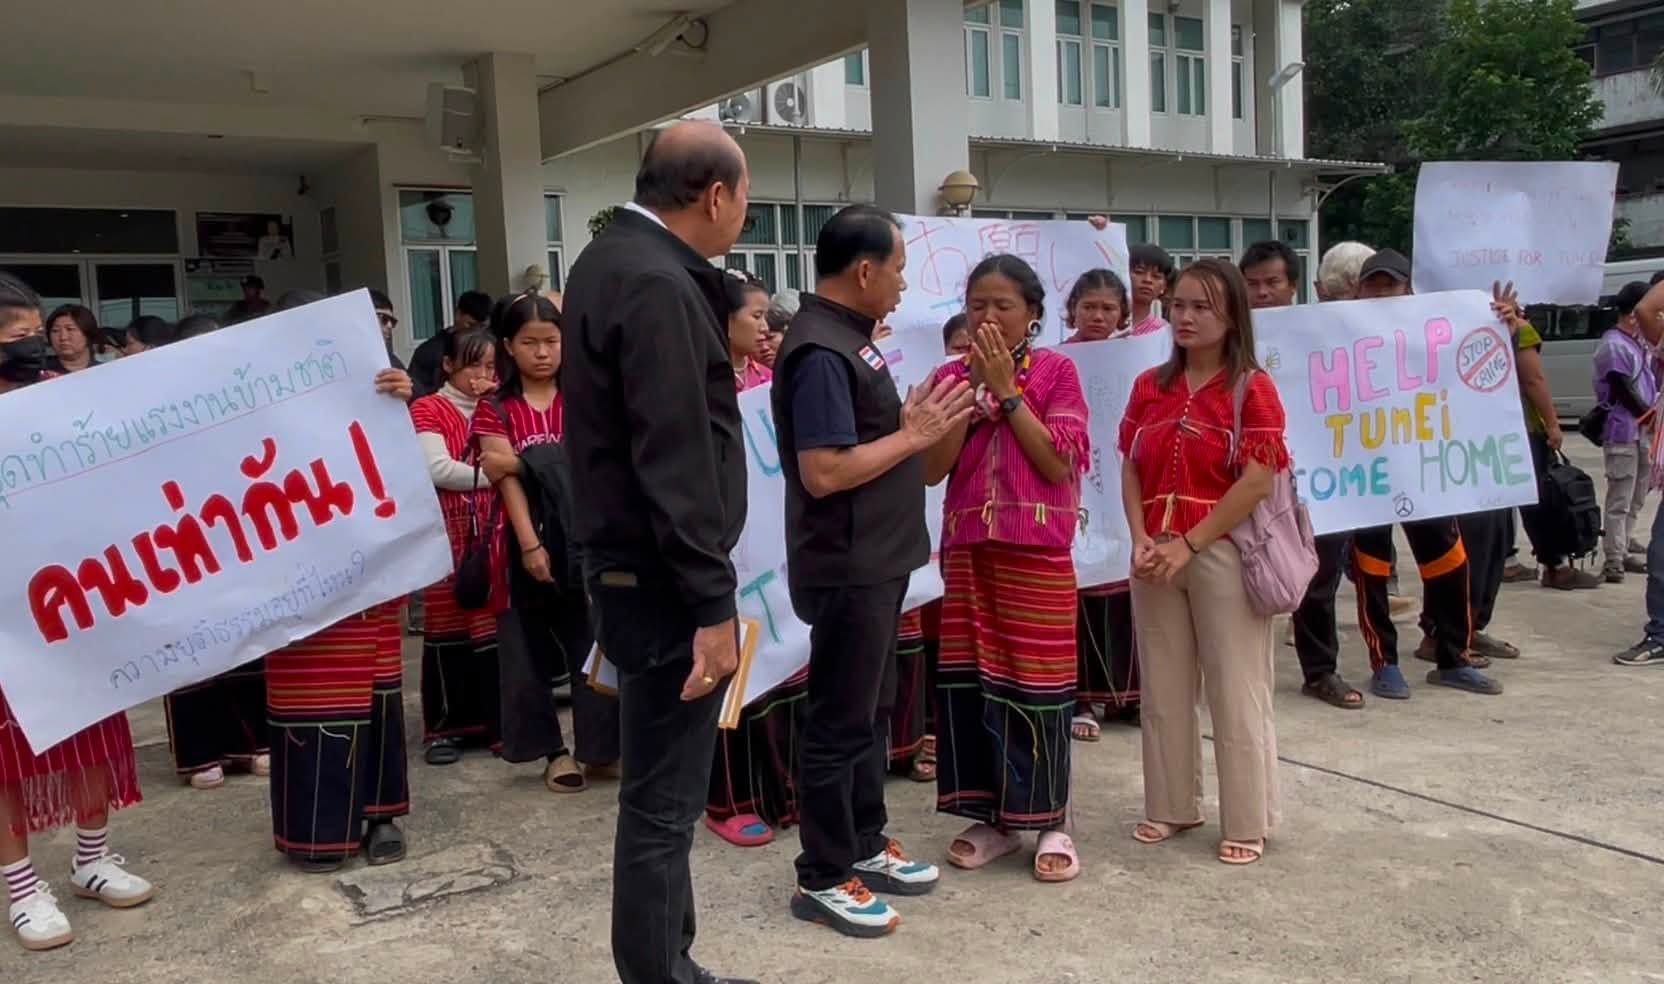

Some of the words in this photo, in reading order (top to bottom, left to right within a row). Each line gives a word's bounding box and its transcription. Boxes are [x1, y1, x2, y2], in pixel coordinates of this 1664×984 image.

[1519, 249, 1545, 266] FOR
[1308, 316, 1453, 414] HELP
[1462, 335, 1493, 367] STOP
[1473, 351, 1506, 389] CRIME
[1419, 432, 1531, 494] HOME
